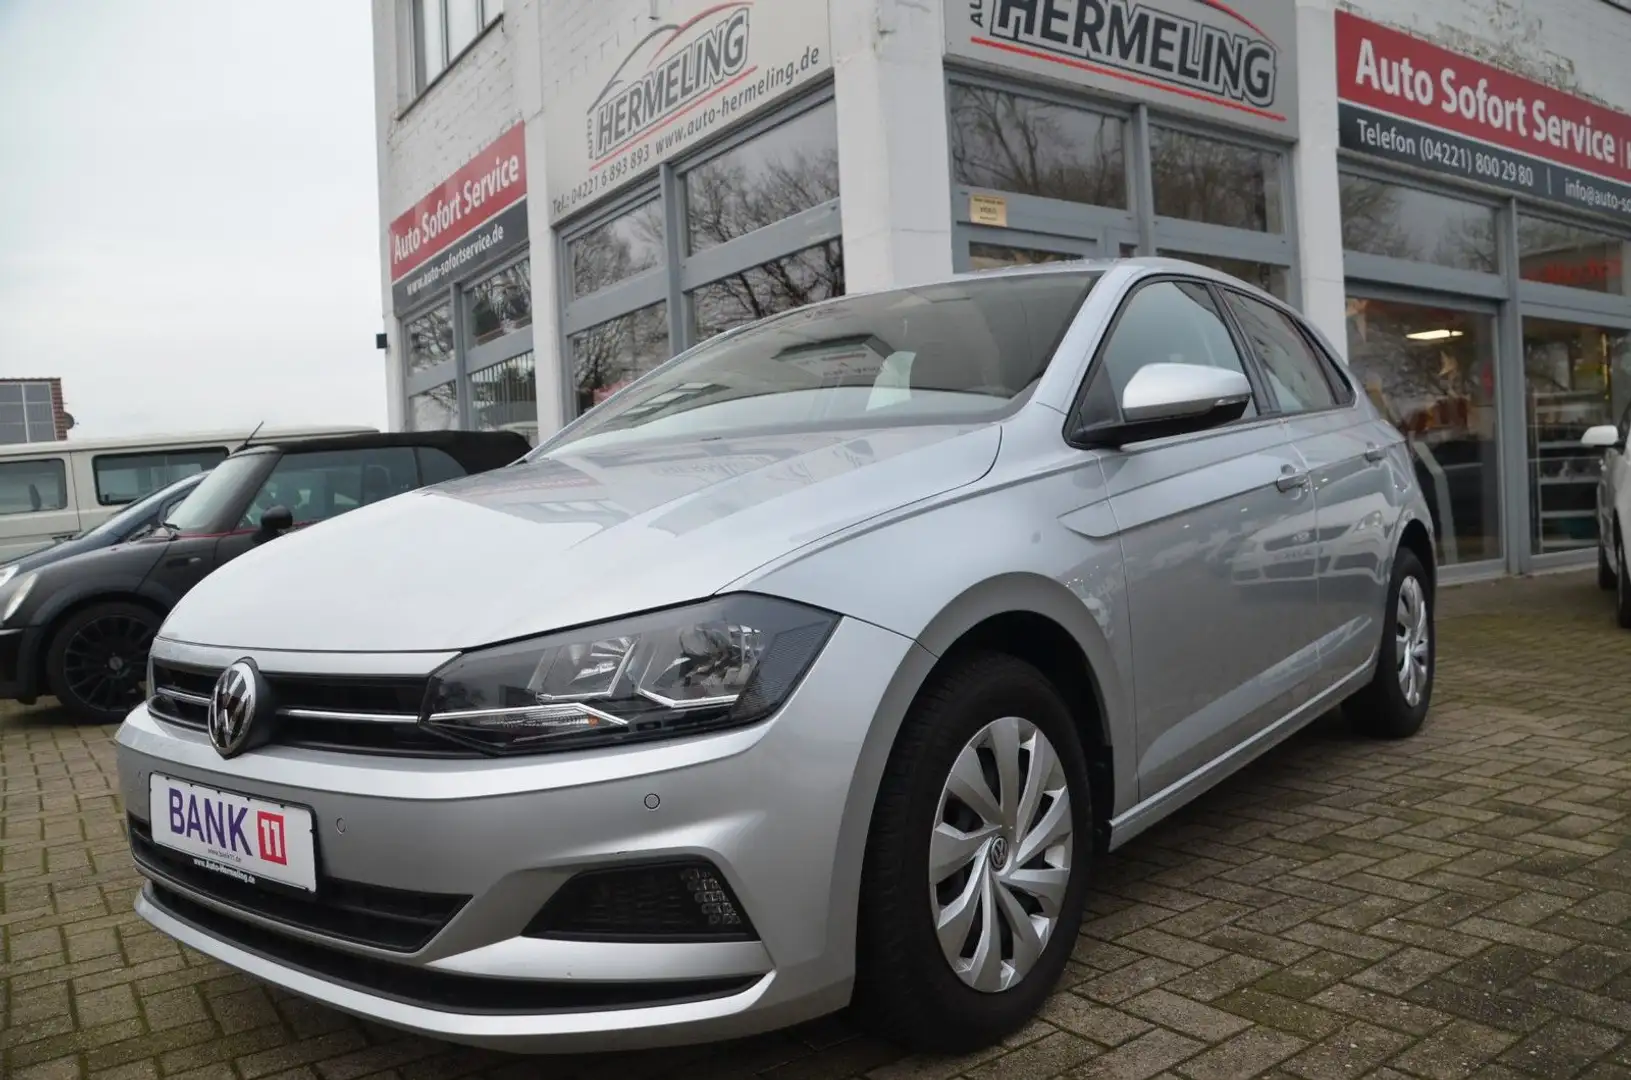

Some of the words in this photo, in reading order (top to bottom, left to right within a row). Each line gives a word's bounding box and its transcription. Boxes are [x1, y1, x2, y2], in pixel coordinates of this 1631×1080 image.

[596, 11, 748, 157] HERMELING
[994, 0, 1274, 103] HERMELING
[1355, 37, 1434, 106] Auto
[1440, 68, 1527, 137] Sofort
[1532, 100, 1616, 164] Service
[572, 175, 598, 204] 04221
[609, 157, 628, 181] 893
[630, 144, 650, 169] 893
[655, 46, 820, 155] www.auto-hermeling.de
[1356, 118, 1416, 155] Telefon
[1419, 136, 1472, 175] (04221)
[1475, 152, 1500, 178] 800
[1501, 159, 1517, 182] 29
[1518, 166, 1534, 187] 80
[393, 224, 421, 265] Auto
[422, 192, 461, 244] Sofort
[463, 155, 519, 215] Service
[406, 224, 505, 295] www.auto-sofortservice.de
[168, 787, 254, 857] BANK
[260, 818, 282, 859] 11
